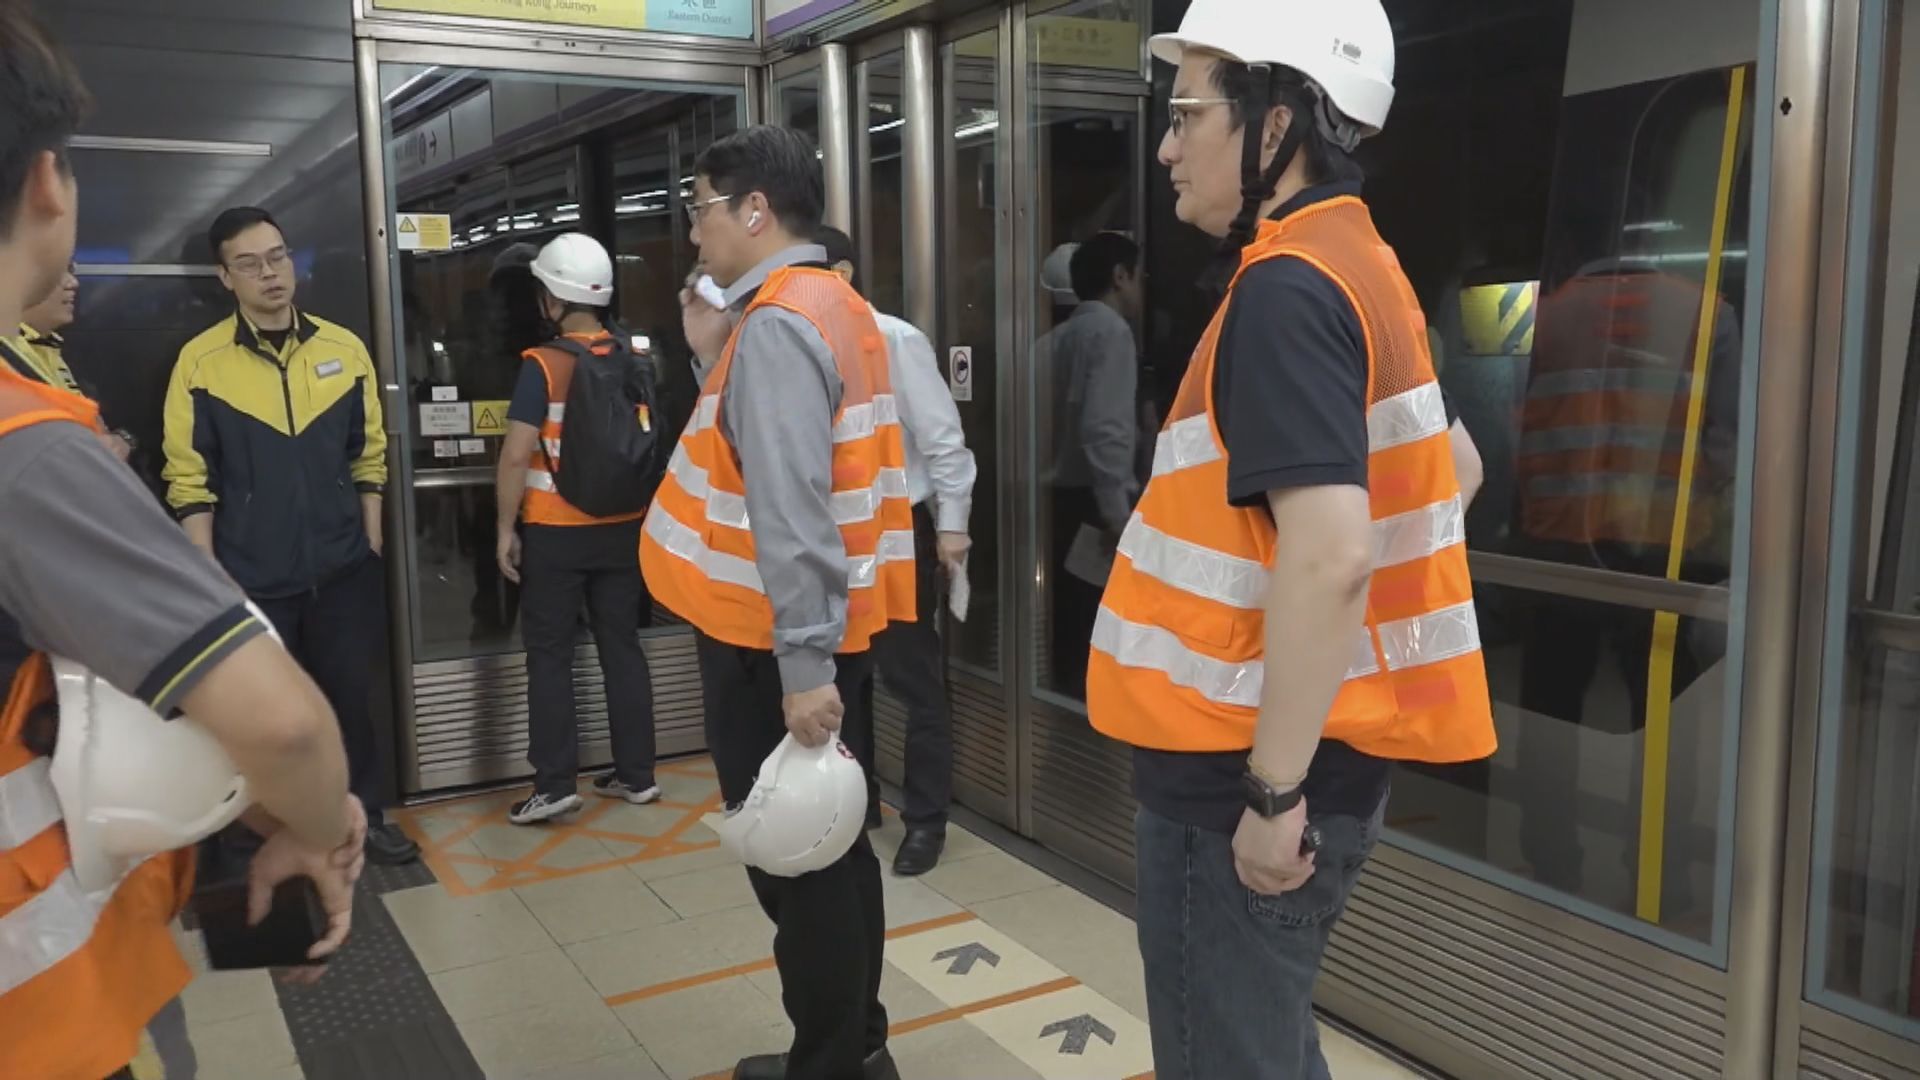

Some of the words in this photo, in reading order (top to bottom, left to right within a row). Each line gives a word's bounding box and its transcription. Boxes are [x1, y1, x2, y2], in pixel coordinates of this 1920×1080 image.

[553, 0, 597, 13] Journeys
[667, 9, 699, 22] Eastern
[702, 13, 732, 25] District
